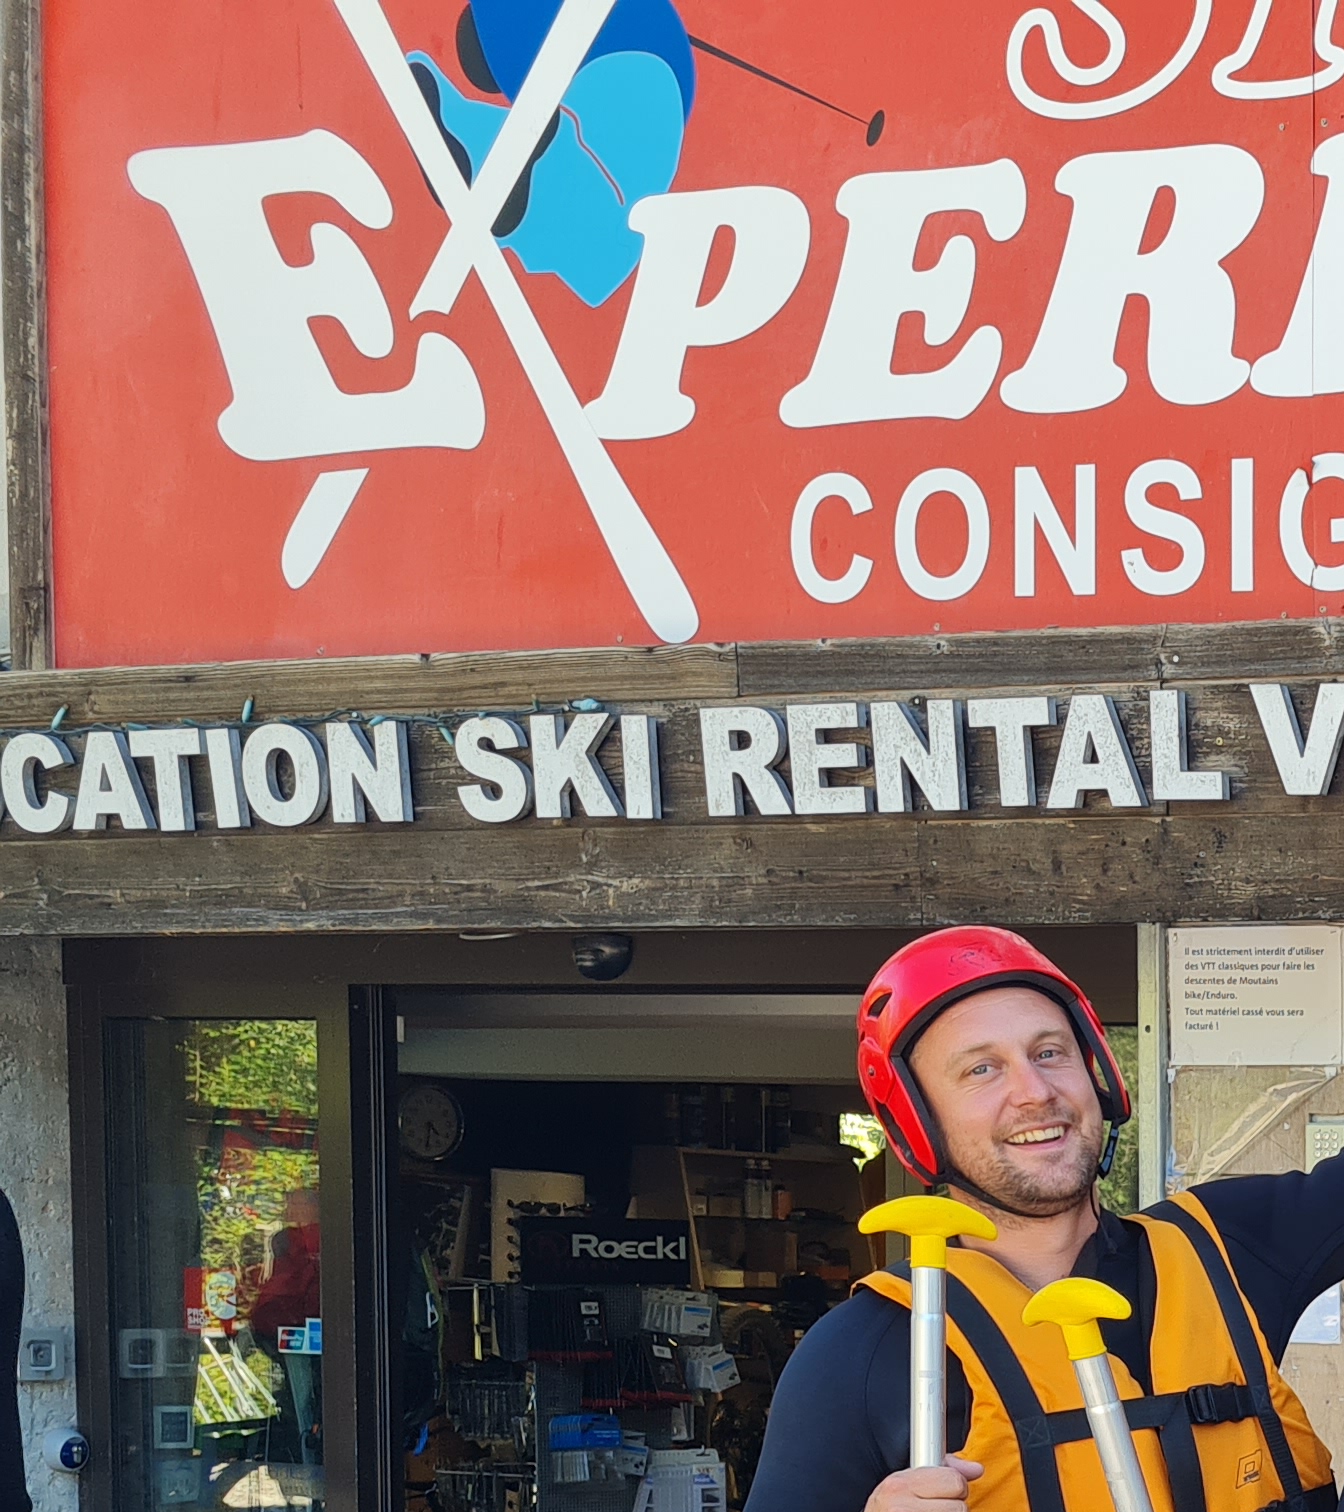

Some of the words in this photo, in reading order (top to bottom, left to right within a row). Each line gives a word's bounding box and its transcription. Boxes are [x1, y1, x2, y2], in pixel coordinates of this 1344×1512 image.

[455, 713, 662, 823] SKI
[700, 688, 1230, 818] RENTAL
[1191, 948, 1203, 956] est
[1206, 947, 1252, 956] strictement
[1254, 947, 1285, 956] interdit
[1184, 962, 1198, 970] des
[1200, 962, 1216, 970] VTT
[1218, 961, 1259, 972] classiques
[1260, 963, 1280, 972] pour
[1282, 961, 1301, 970] faire
[1303, 961, 1315, 970] les
[1184, 976, 1225, 985] descentes
[1226, 976, 1237, 985] de
[1239, 976, 1278, 985] Moutains
[1184, 1007, 1203, 1016] Tout
[1205, 1007, 1240, 1016] matériel
[1241, 1008, 1263, 1016] cassé
[1184, 1021, 1214, 1030] facturé
